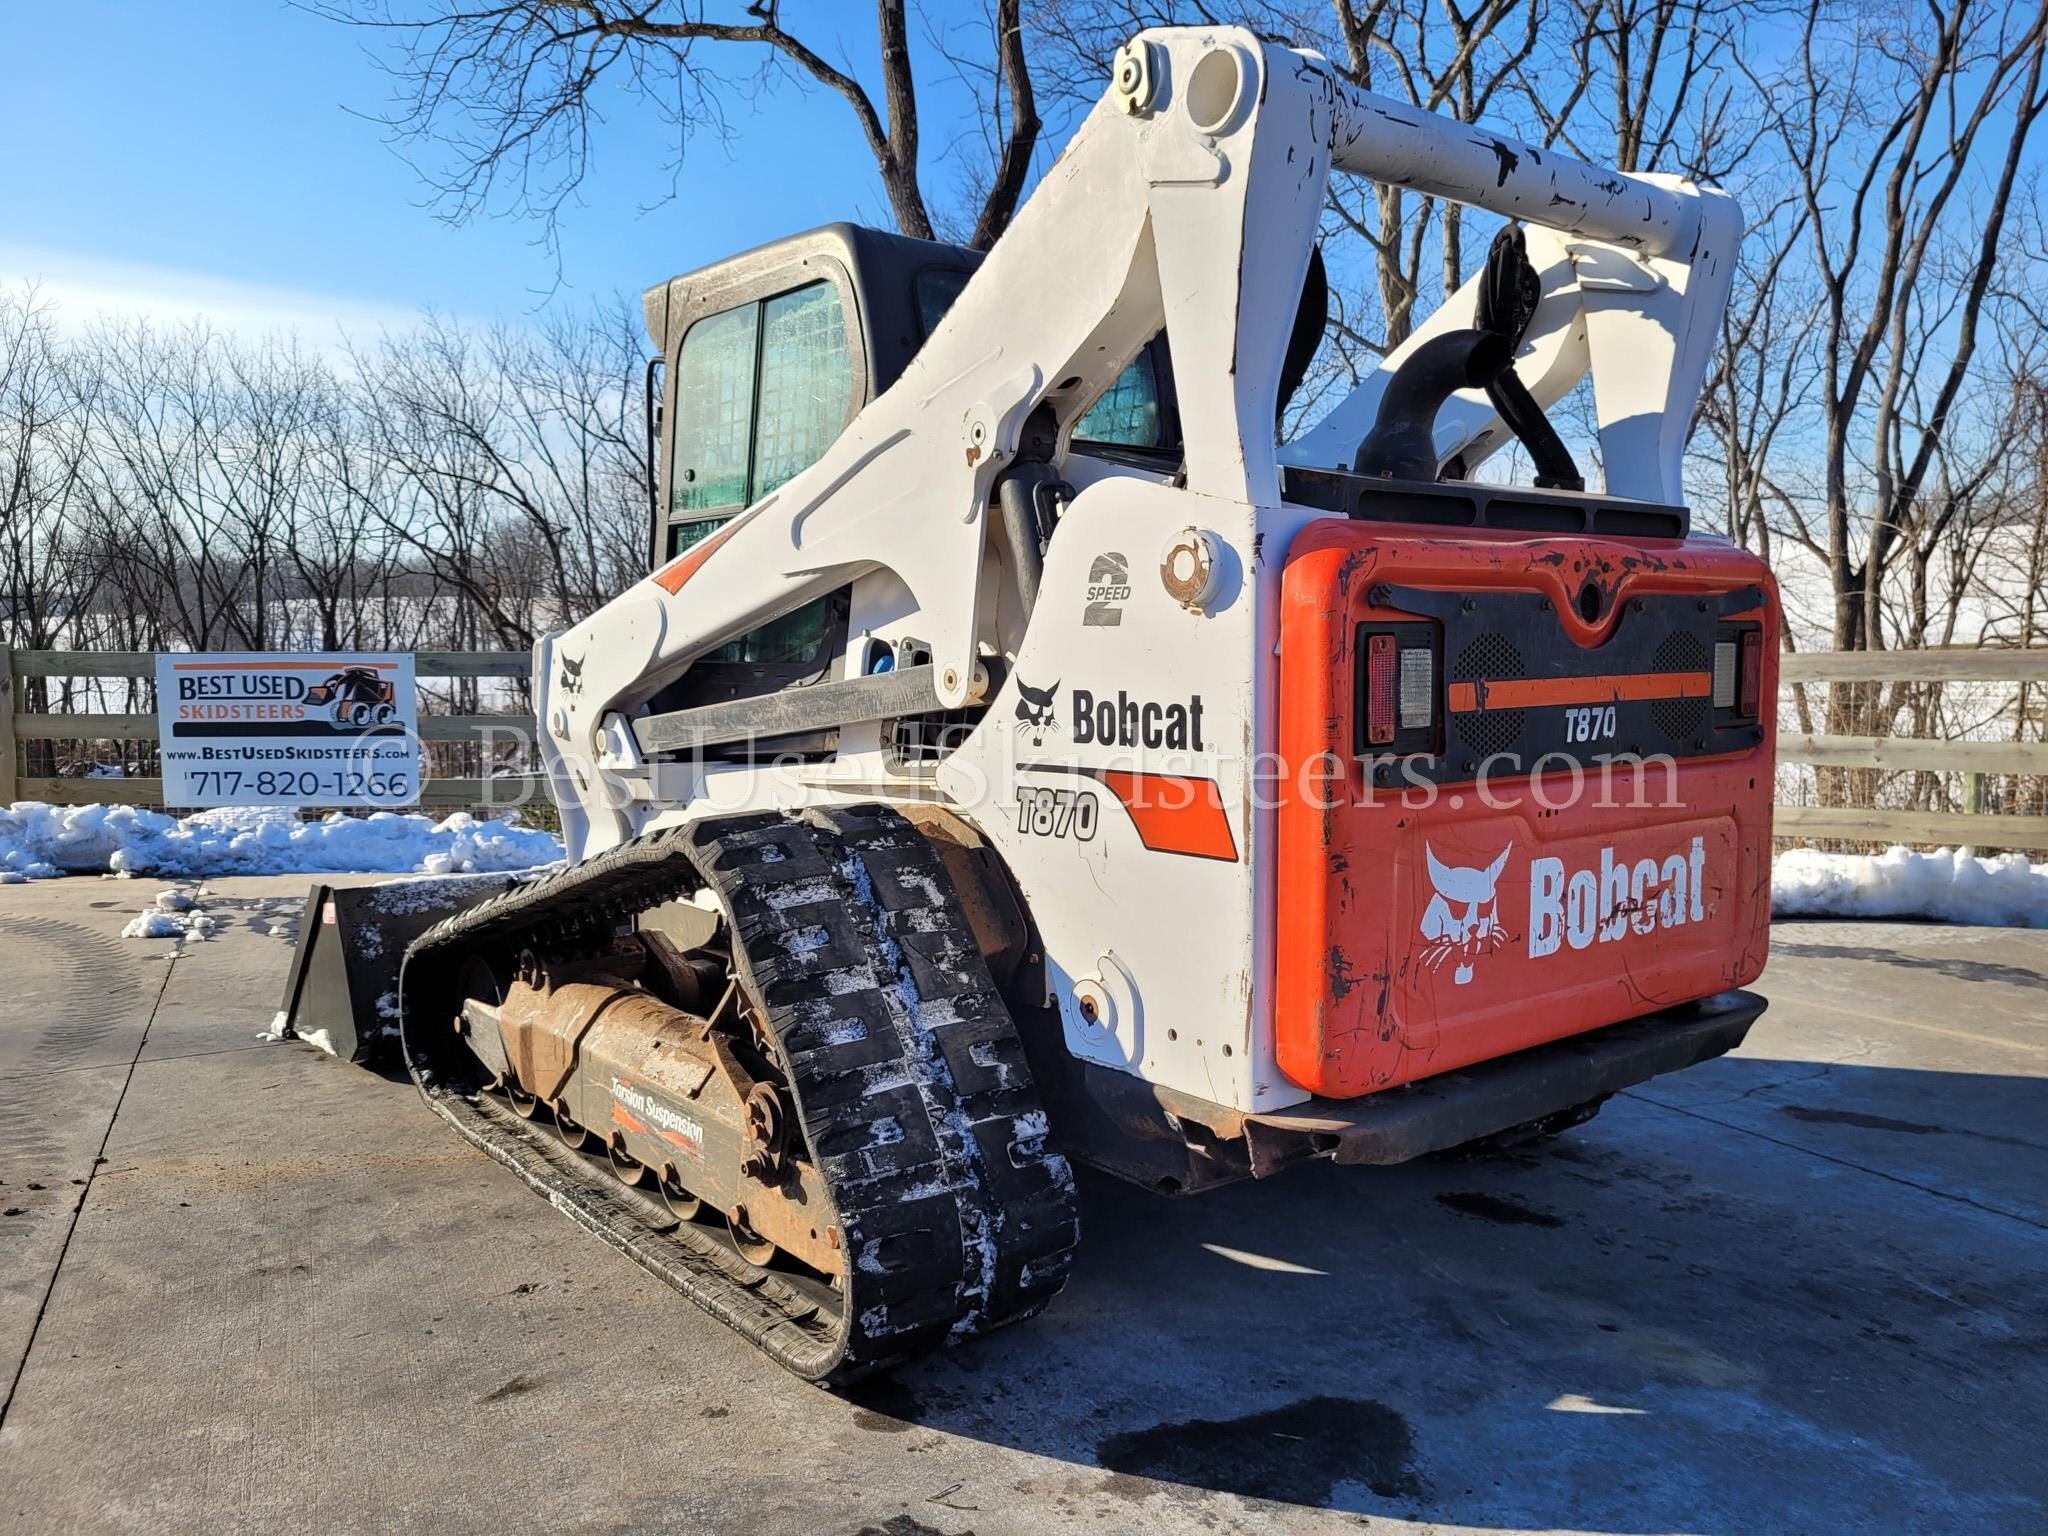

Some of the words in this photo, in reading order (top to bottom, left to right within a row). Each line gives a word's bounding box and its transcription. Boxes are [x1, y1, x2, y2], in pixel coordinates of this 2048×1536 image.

[1086, 586, 1132, 601] SPEED
[179, 675, 235, 700] BEST
[242, 675, 305, 700] USED
[179, 704, 305, 719] SKIDSTEERS
[1072, 689, 1204, 752] Bobcat
[1565, 706, 1616, 743] T870
[1016, 785, 1098, 842] T870
[1528, 836, 1705, 959] Bobcat
[611, 1077, 645, 1112] Torsion
[646, 1096, 703, 1143] Suspension
